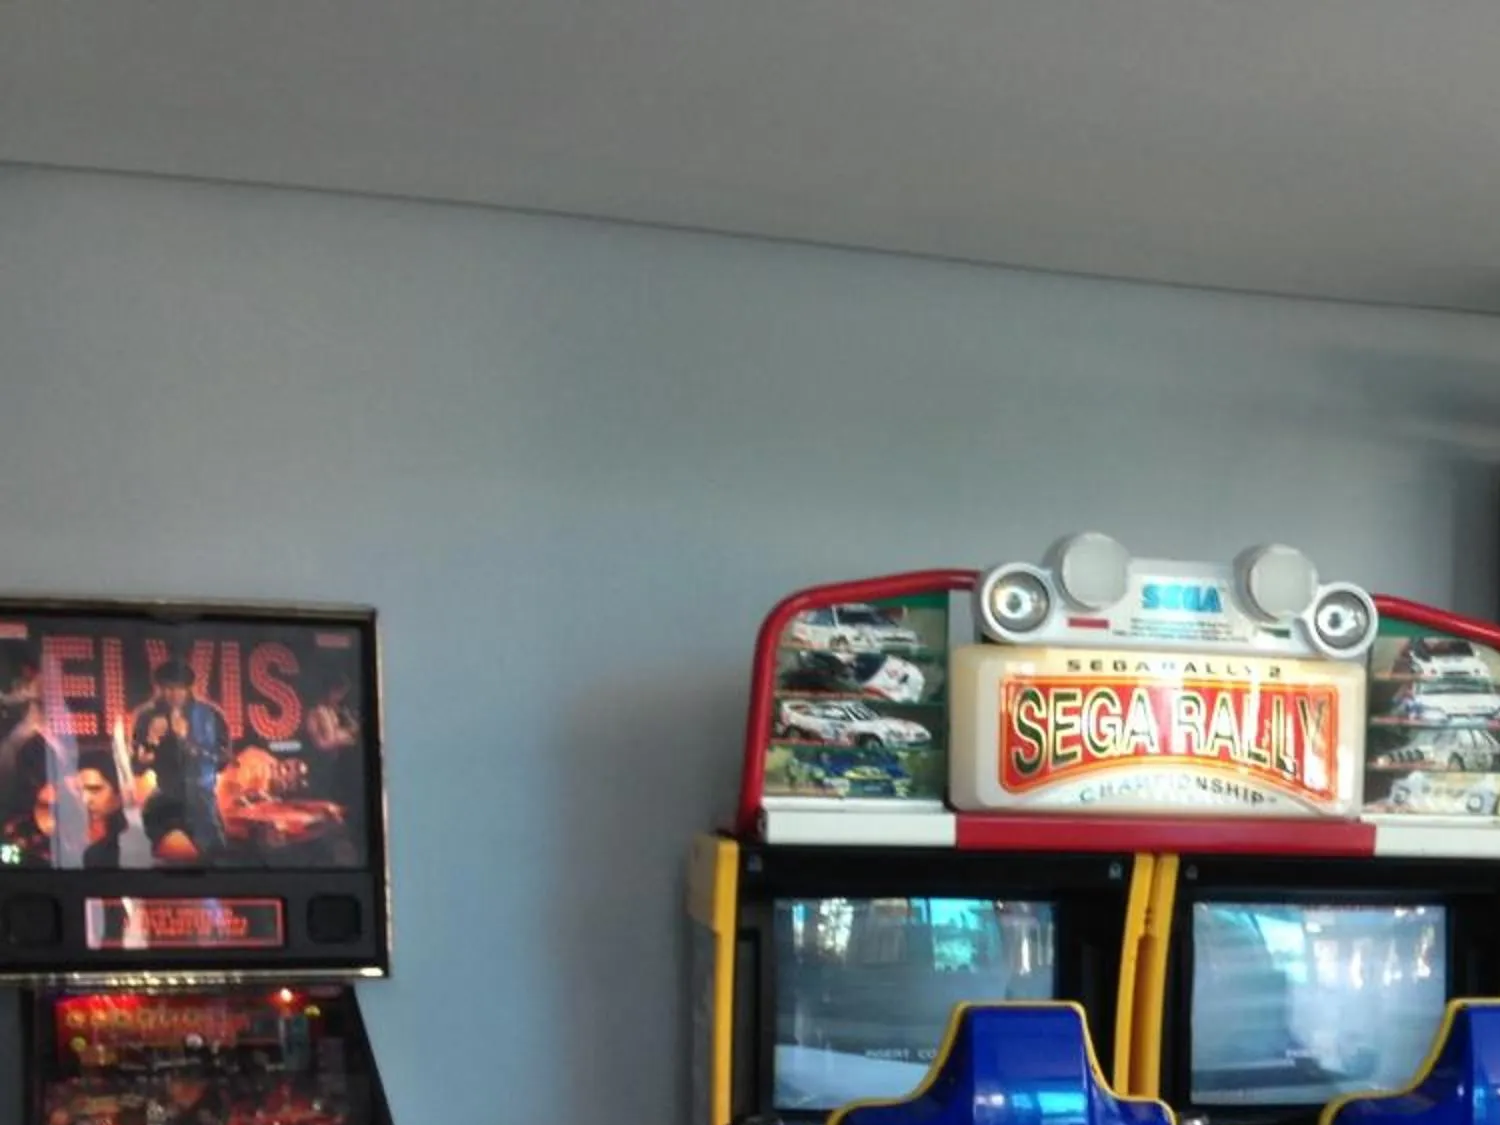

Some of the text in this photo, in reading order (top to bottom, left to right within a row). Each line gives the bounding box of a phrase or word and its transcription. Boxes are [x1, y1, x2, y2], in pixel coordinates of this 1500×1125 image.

[41, 636, 301, 740] ELVIS
[1012, 687, 1330, 791] SEGA RALLY
